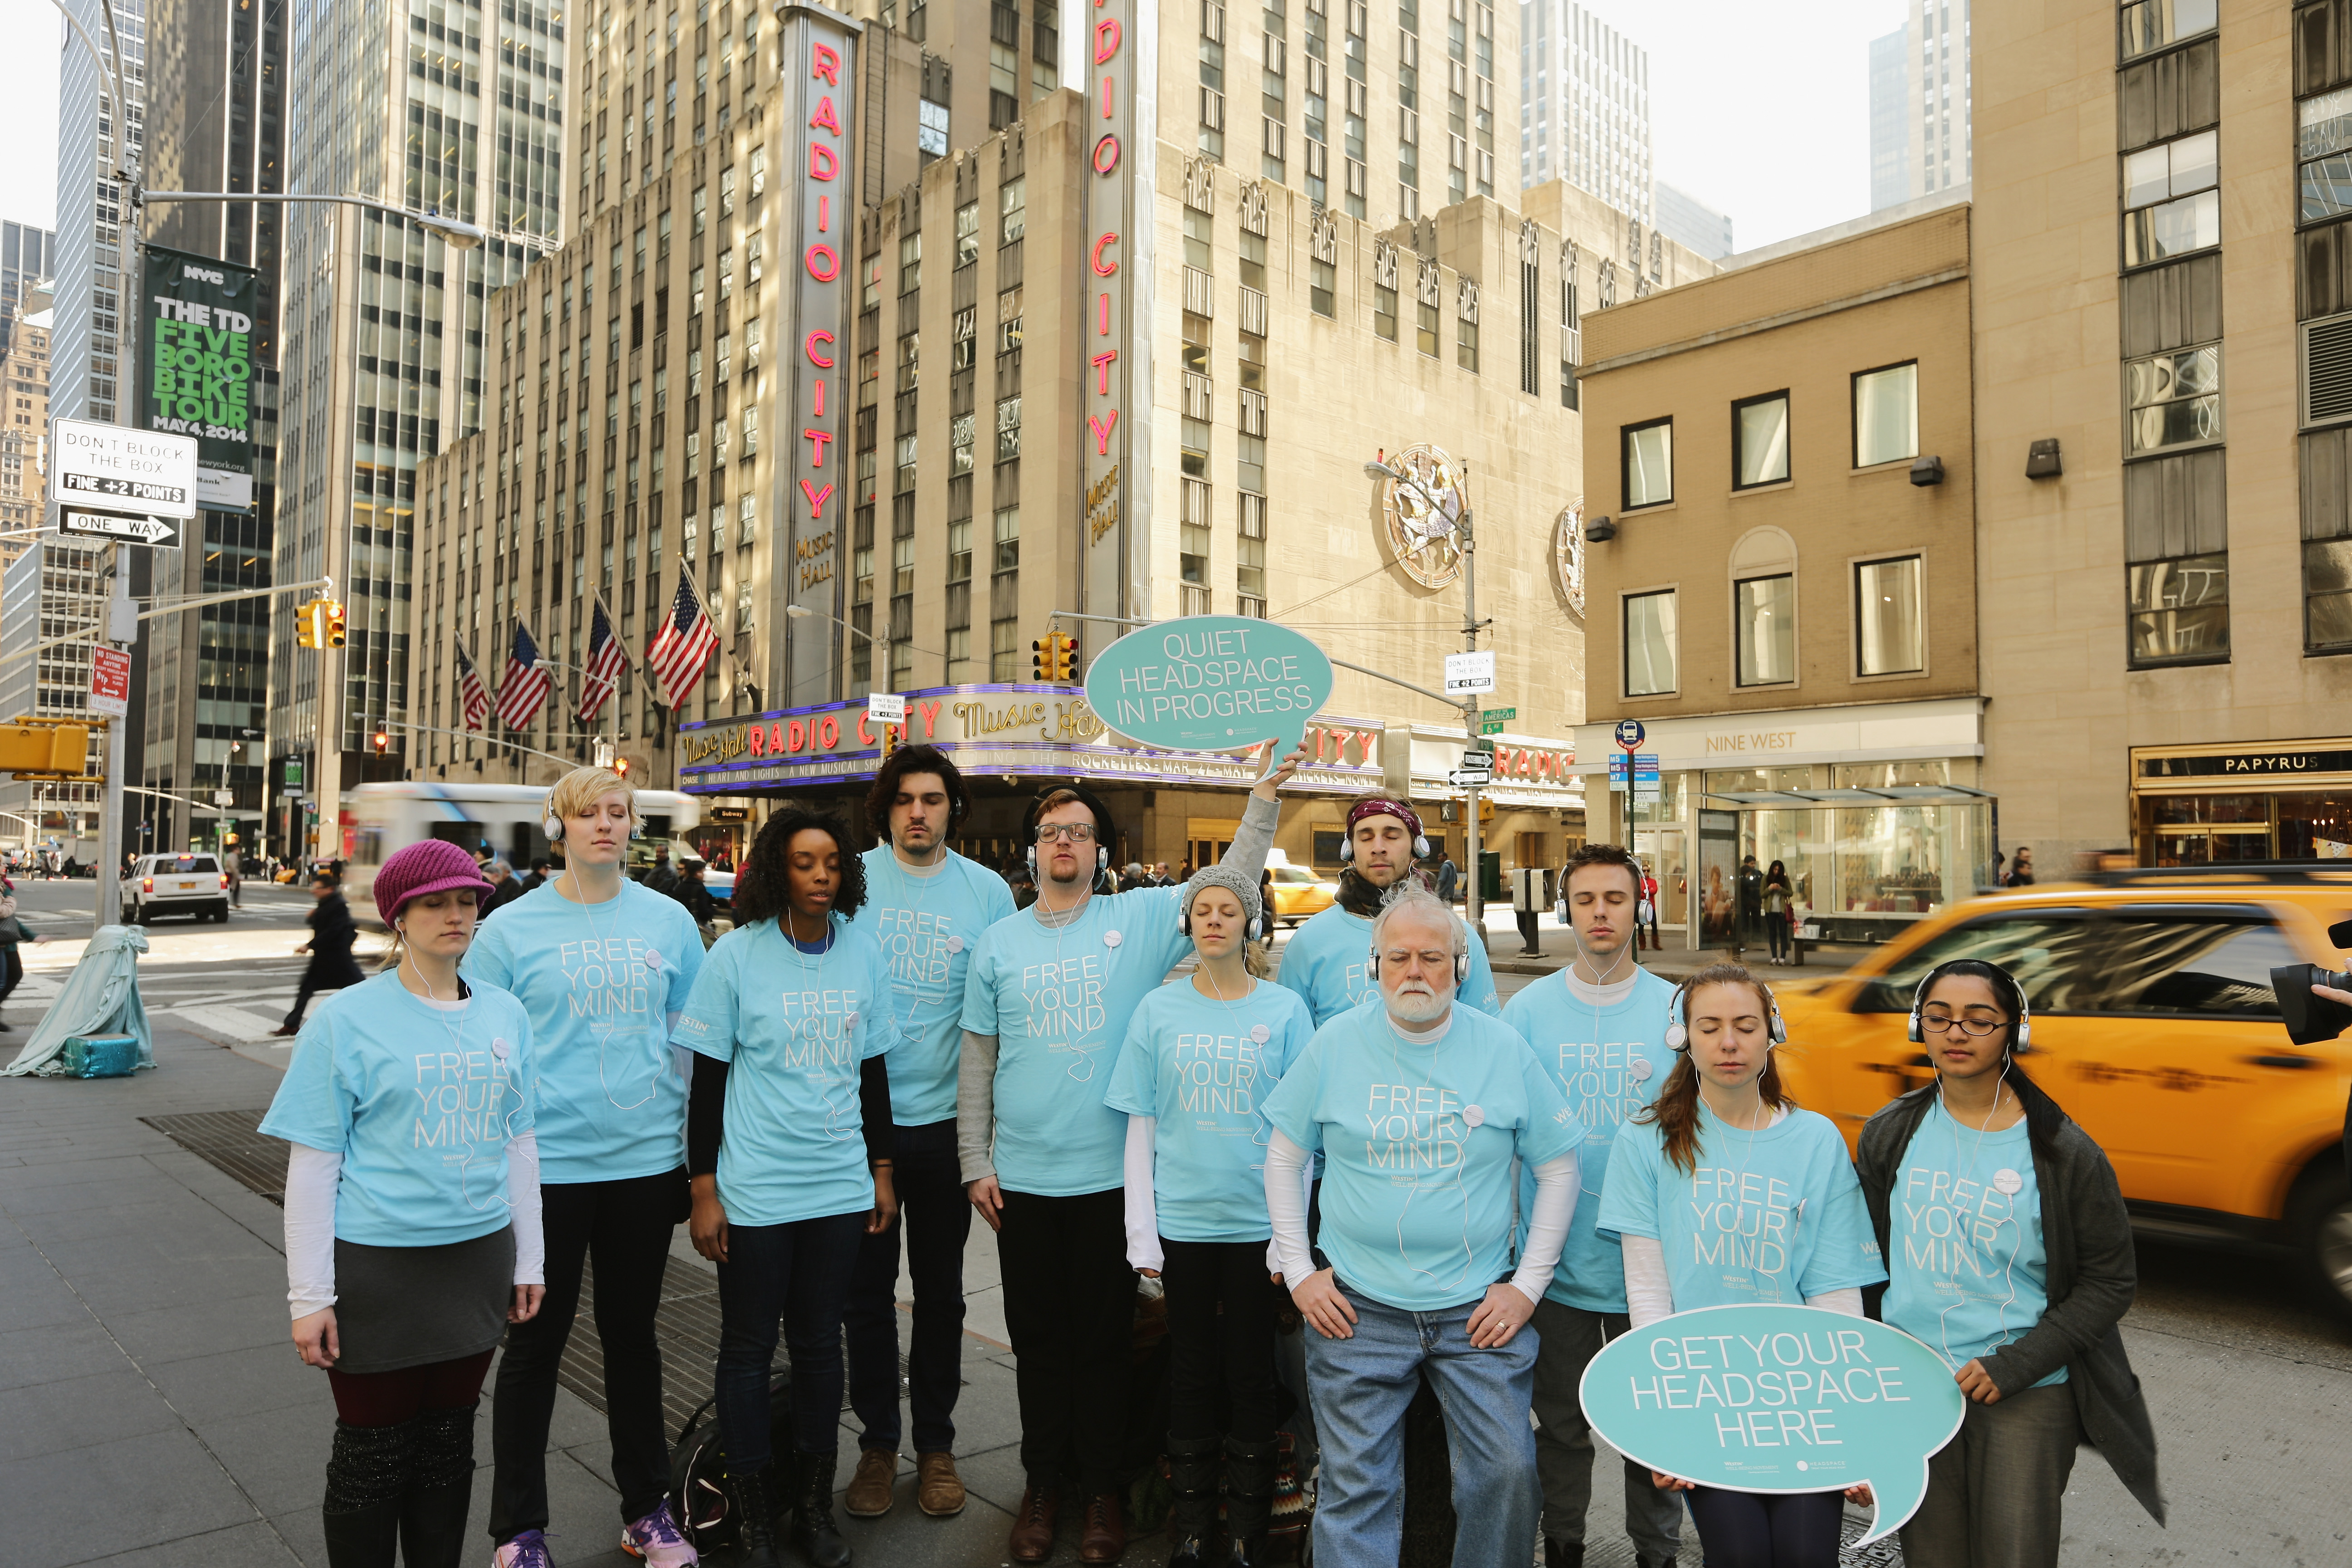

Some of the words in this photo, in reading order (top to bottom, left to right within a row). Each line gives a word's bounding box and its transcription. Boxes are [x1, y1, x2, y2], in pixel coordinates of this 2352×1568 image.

[805, 43, 841, 282] RADIO
[184, 265, 224, 285] NYC
[154, 295, 210, 327] THE
[214, 307, 251, 333] TD
[155, 317, 249, 358] FIVE
[1089, 232, 1118, 455] CITY
[155, 342, 250, 381] BORO
[154, 366, 247, 406] BIKE
[152, 391, 248, 430] TOUR
[800, 329, 834, 518] CITY
[153, 416, 190, 433] MAY
[189, 421, 204, 436] 4,
[206, 424, 248, 443] 2014
[67, 433, 118, 451] DONT
[127, 442, 183, 461] BLOCK
[89, 453, 122, 468] THE
[131, 459, 163, 474] BOX
[68, 474, 99, 491] FINE
[105, 480, 128, 495] +2
[133, 484, 181, 502] POINTS
[197, 477, 220, 485] Bank
[1086, 465, 1118, 518] MUSIC
[78, 515, 112, 530] ONE
[129, 521, 162, 536] WAY
[1092, 500, 1118, 547] HALL
[796, 531, 833, 566] MUSIC
[800, 560, 833, 593] HALL
[97, 650, 104, 658] NO
[106, 652, 128, 664] STANDING
[1162, 629, 1250, 664] QUIET
[103, 660, 121, 669] ANYTIME
[1119, 655, 1301, 694] HEADSPACE
[98, 699, 111, 707] HOUR
[113, 702, 124, 710] LIMIT
[1116, 697, 1146, 725] IN
[1152, 684, 1313, 722] PROGRESS
[1485, 711, 1514, 721] AMERICAS
[682, 734, 718, 765] Music
[714, 722, 747, 764] Hall
[750, 715, 839, 756] RADIO
[857, 701, 941, 745] CTY
[953, 702, 1046, 739] Music
[1486, 724, 1492, 734] 6
[1624, 740, 1643, 749] STANDING
[1707, 735, 1745, 752] NINE
[1750, 732, 1796, 749] WEST
[682, 775, 699, 785] CHASE
[708, 771, 730, 784] HEART
[735, 770, 749, 781] AND
[753, 767, 780, 779] LIGHTS
[789, 766, 794, 777] A
[799, 764, 816, 776] NEW
[821, 760, 858, 774] MUSICAL
[1031, 751, 1059, 764] THE
[1072, 753, 1150, 771] ROCKETTES
[1163, 760, 1189, 774] MAR
[1198, 763, 1210, 775] 27
[1223, 764, 1248, 777] MAY
[1297, 770, 1339, 784] TICKETS
[2226, 756, 2318, 771] PAPYRUS
[878, 908, 952, 937] FREE
[560, 938, 646, 966] FREE
[876, 931, 949, 960] YOUR
[561, 962, 649, 990] YOUR
[1023, 955, 1101, 989] FREE
[567, 986, 648, 1018] MIND
[783, 990, 858, 1016] FREE
[1021, 980, 1103, 1013] YOUR
[679, 1014, 707, 1032] ESTIN
[1026, 1004, 1106, 1038] MIND
[785, 1040, 852, 1068] MIND
[1176, 1034, 1255, 1063] FREE
[1559, 1043, 1645, 1069] FREE
[415, 1051, 508, 1083] FREE
[1174, 1060, 1253, 1088] YOUR
[414, 1083, 505, 1116] YOUR
[1368, 1084, 1458, 1114] FREE
[1558, 1071, 1644, 1098] YOUR
[1178, 1085, 1252, 1115] MIND
[414, 1112, 503, 1148] MIND
[1365, 1113, 1459, 1142] YOUR
[1366, 1140, 1461, 1169] MIND
[1693, 1167, 1789, 1211] FREE
[1907, 1167, 2009, 1224] FREE
[1690, 1201, 1785, 1244] YOUR
[1903, 1202, 1997, 1256] YOUR
[1694, 1232, 1786, 1274] MIND
[1722, 1274, 1747, 1283] WESTIN
[1722, 1282, 1756, 1290] WELL-BEIN
[1650, 1335, 1733, 1371] GET
[1739, 1330, 1872, 1367] YOUR
[1630, 1367, 1911, 1410] HEADSPACE
[1714, 1409, 1843, 1448] HERE
